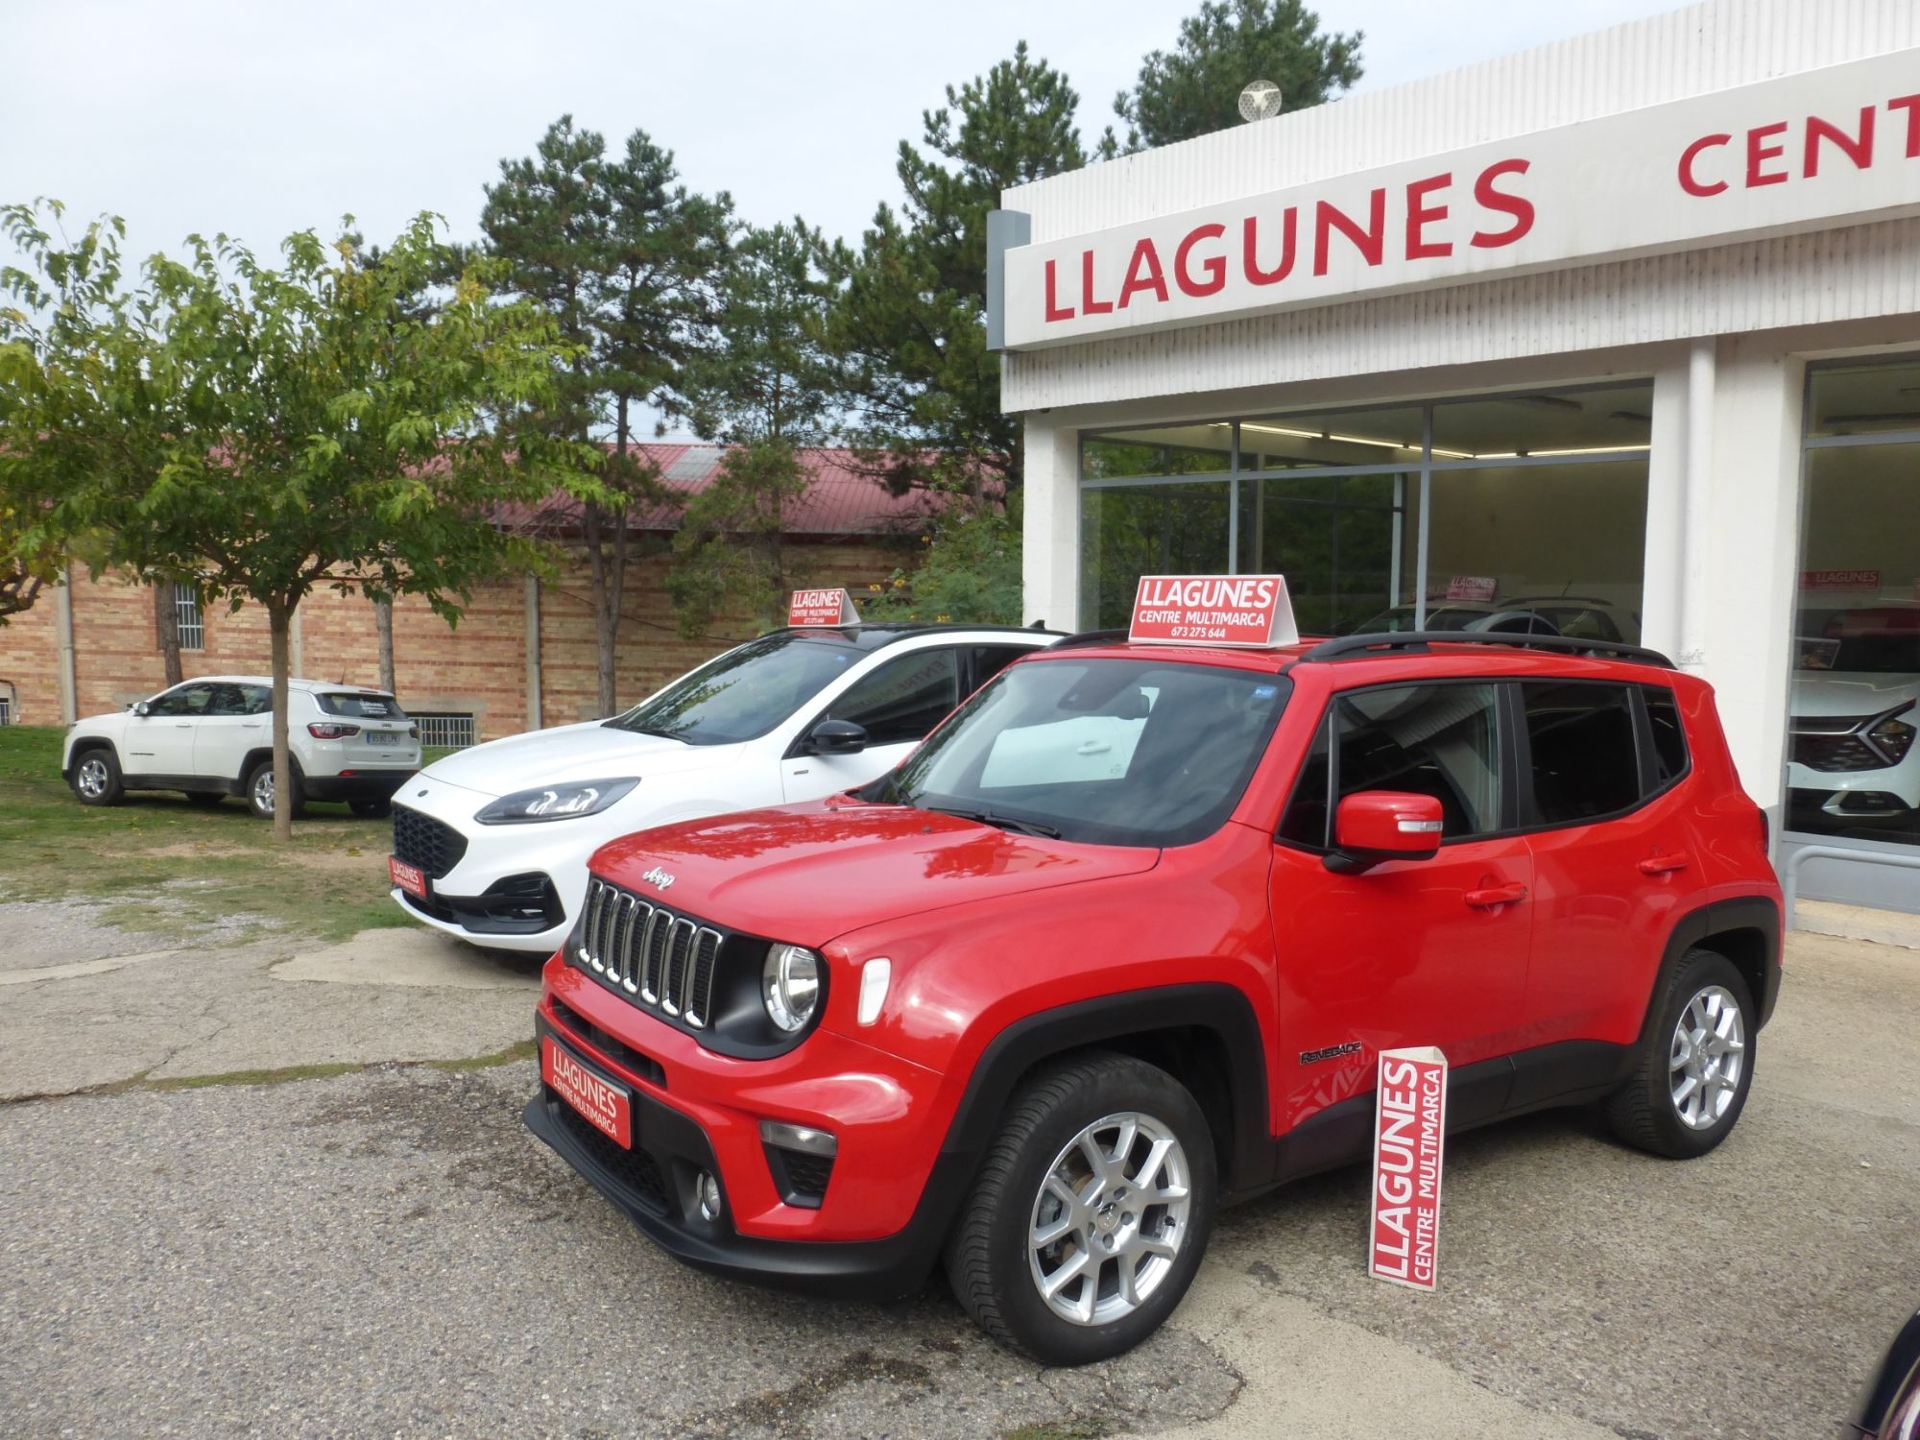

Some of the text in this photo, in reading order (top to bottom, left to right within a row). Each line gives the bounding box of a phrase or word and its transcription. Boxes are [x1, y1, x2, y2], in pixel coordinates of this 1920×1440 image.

[1044, 93, 1920, 323] LLAGUNES CENT
[792, 591, 840, 608] LLAGUNES
[1140, 580, 1273, 608] LLAGUNES
[1139, 610, 1265, 627] CENTRE MULTIMARCA
[1171, 626, 1225, 639] 673 275 644
[642, 866, 676, 891] Jeep
[1299, 1041, 1363, 1066] RENEGADE
[553, 1046, 617, 1118] LLAGUNES
[553, 1075, 617, 1137] CENTRE MULTIMARCA
[1375, 1061, 1418, 1279] LLAGUNES
[1414, 1069, 1441, 1281] CENTRE MULTIMARCA
